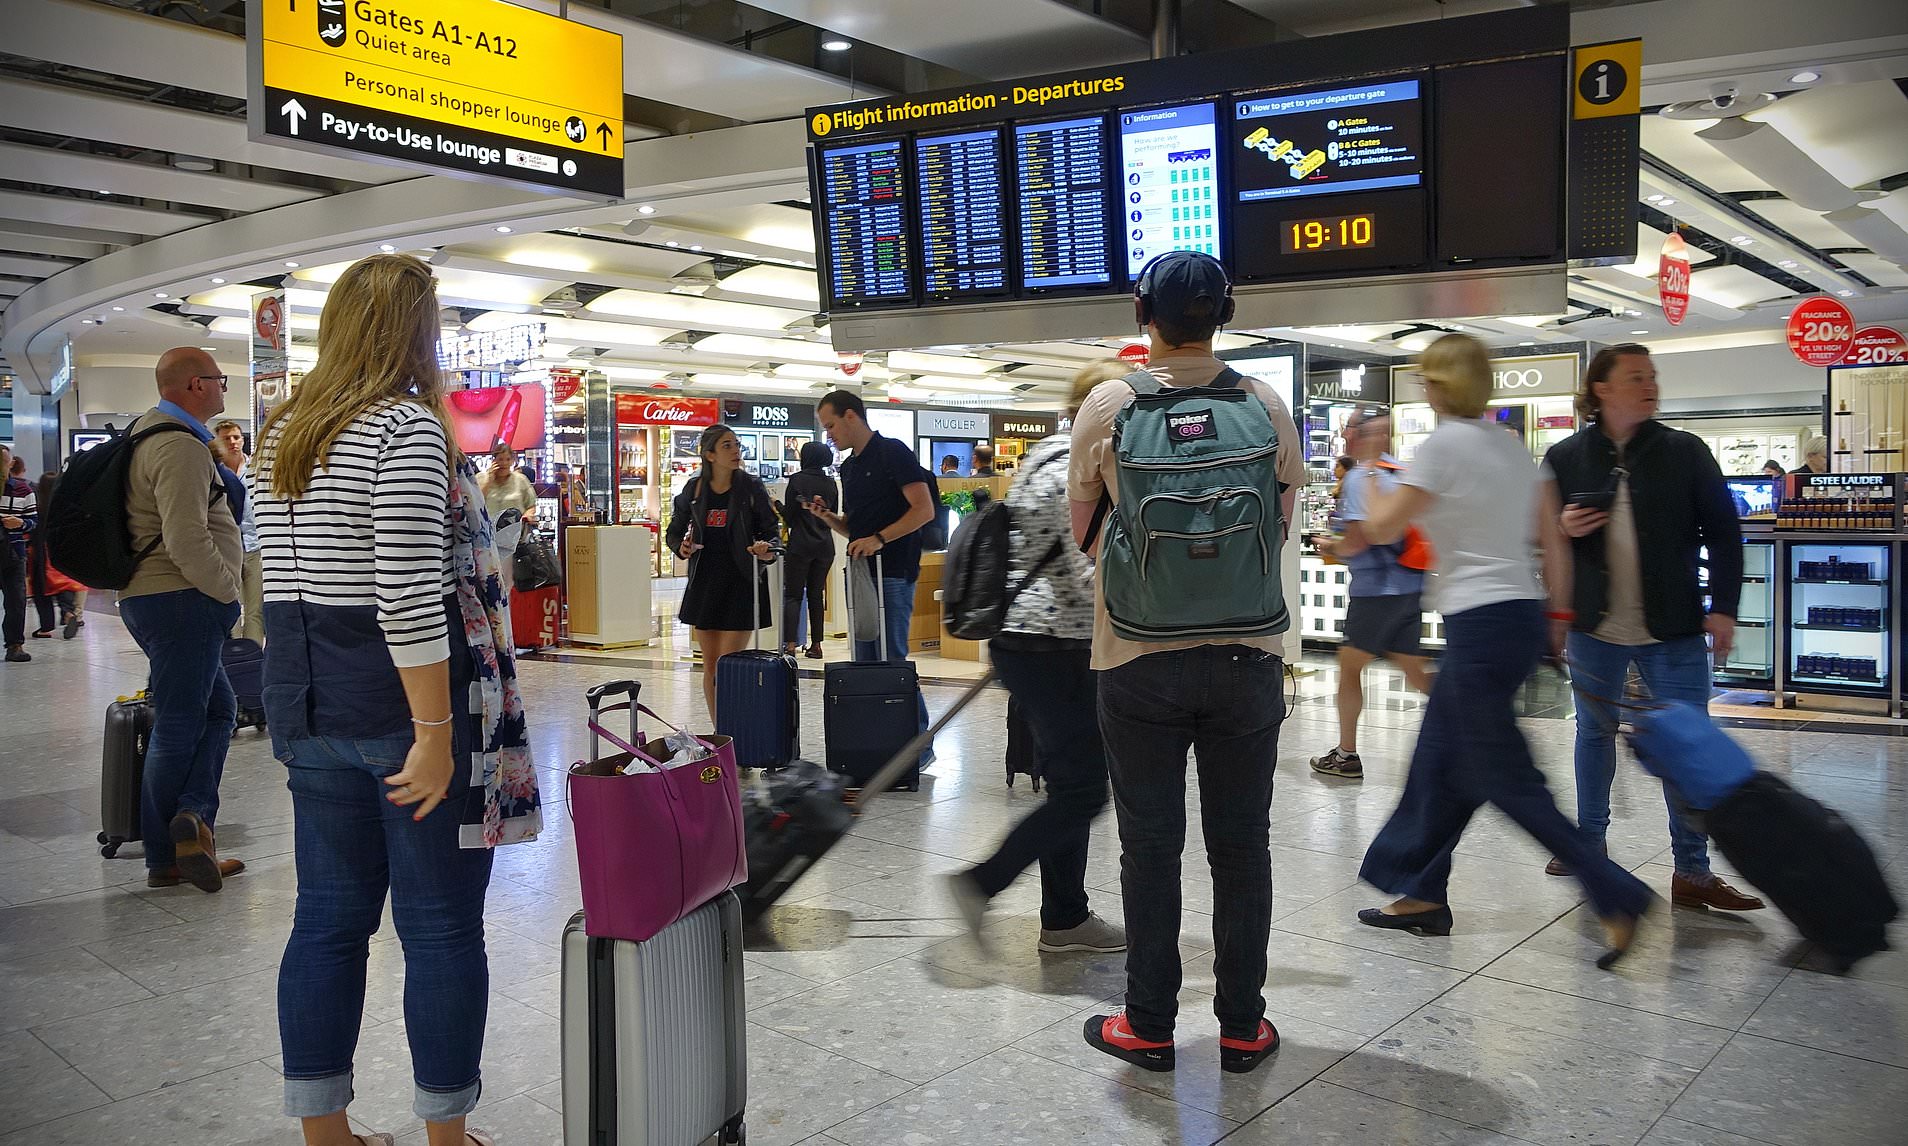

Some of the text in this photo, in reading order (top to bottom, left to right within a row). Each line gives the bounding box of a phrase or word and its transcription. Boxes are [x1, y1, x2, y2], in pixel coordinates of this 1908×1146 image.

[354, 0, 518, 59] Gates A1-A12
[355, 29, 451, 66] Quiet area
[344, 71, 561, 133] Personal shopper lounge
[833, 107, 883, 134] Flight
[887, 91, 997, 122] information
[1012, 74, 1125, 105] Departures
[1251, 89, 1385, 113] How to get to your departure gate
[1133, 111, 1177, 123] Information
[1338, 117, 1368, 127] A Gates
[321, 112, 501, 165] Pay-to-Use lounge
[1338, 128, 1347, 136] 10
[1348, 125, 1380, 135] minutes
[1358, 139, 1381, 147] Gates
[1338, 149, 1357, 158] 5-10
[1357, 147, 1389, 156] minutes
[1338, 157, 1361, 167] 10-20
[1361, 155, 1393, 165] minutes
[1292, 216, 1371, 250] 19:10
[1662, 265, 1688, 295] -20%
[1801, 311, 1842, 319] FRAGRANCE
[1794, 321, 1850, 342] -20%
[1847, 346, 1905, 364] -20%
[643, 400, 694, 421] Cartier
[752, 405, 789, 421] BOSS
[934, 418, 976, 430] MUGLER
[1003, 422, 1046, 433] BVLGARI
[1169, 414, 1209, 428] poker
[1810, 475, 1883, 485] ESTEE LAUDER
